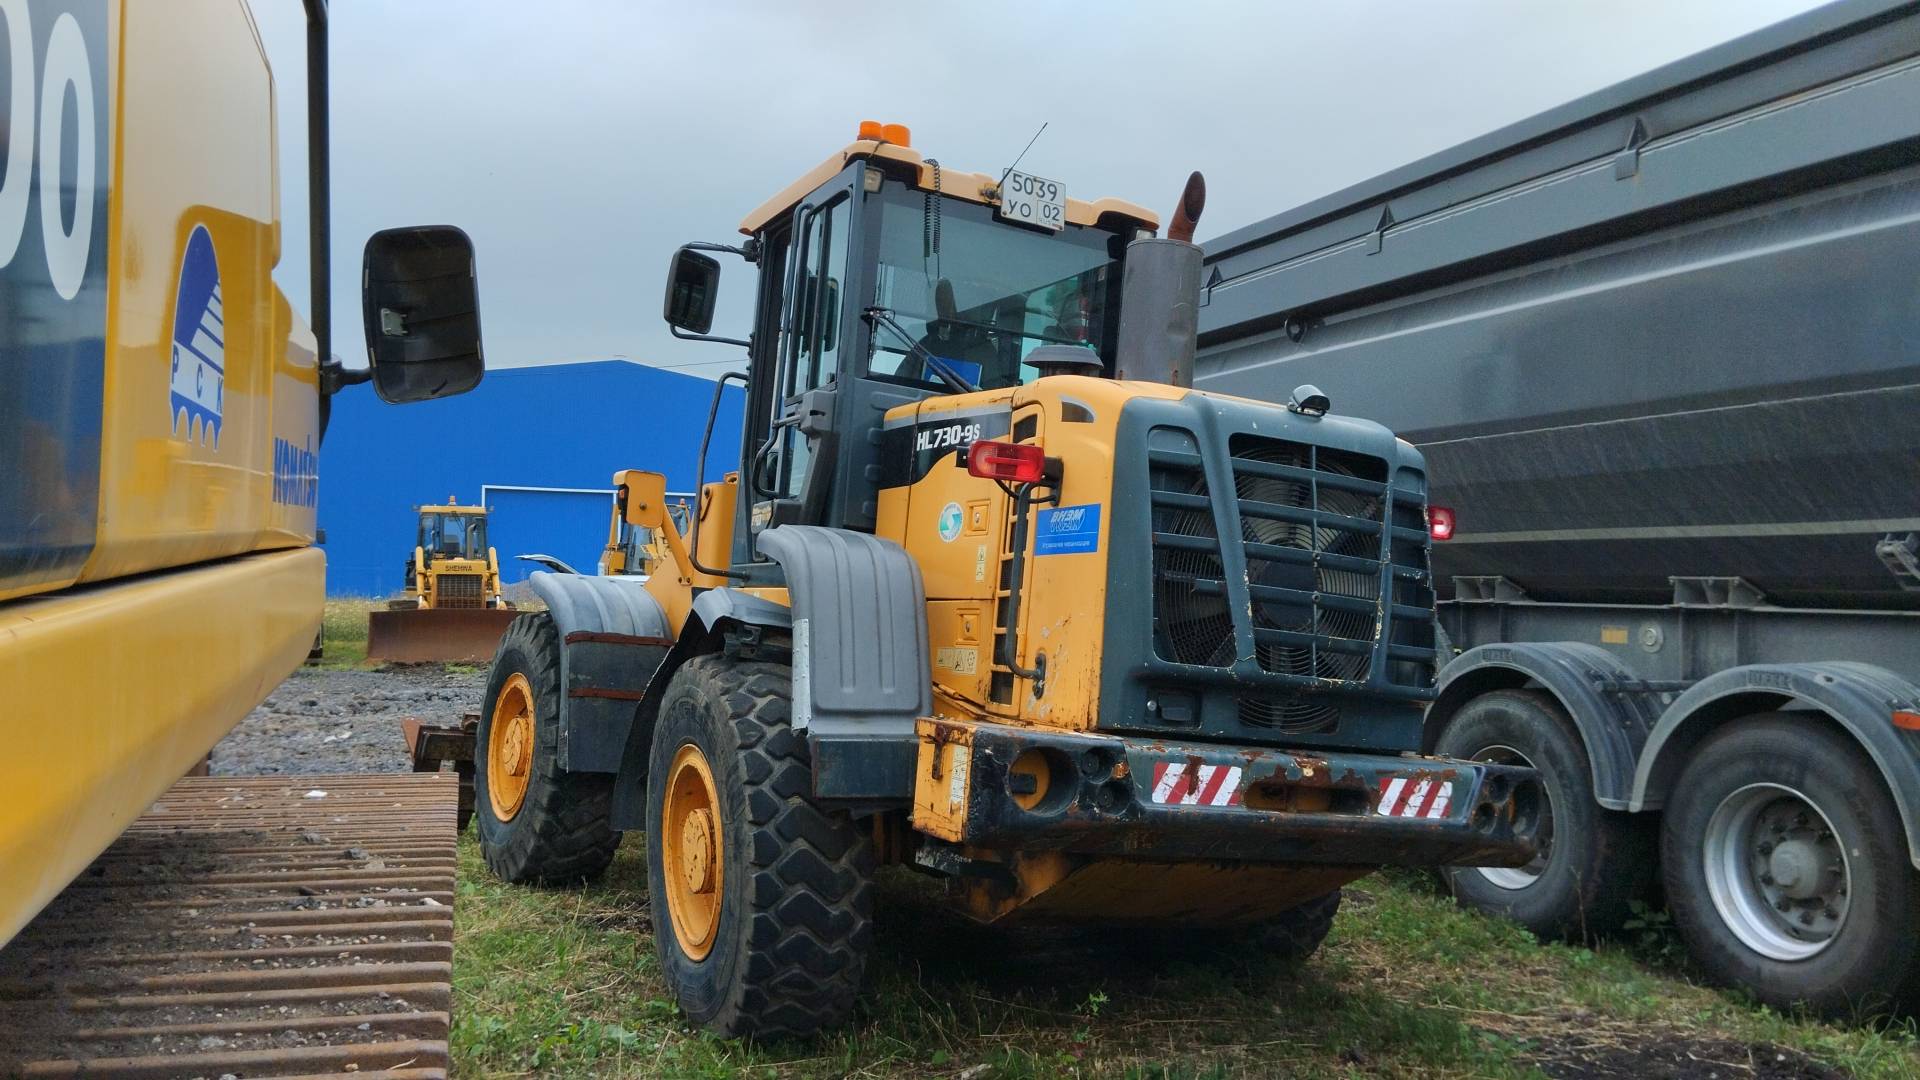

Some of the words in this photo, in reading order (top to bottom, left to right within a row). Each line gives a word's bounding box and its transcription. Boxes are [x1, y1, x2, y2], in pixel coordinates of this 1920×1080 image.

[1012, 173, 1058, 201] 5039
[1008, 199, 1032, 218] УО
[1043, 204, 1060, 222] 02
[916, 423, 980, 452] HL730-9S
